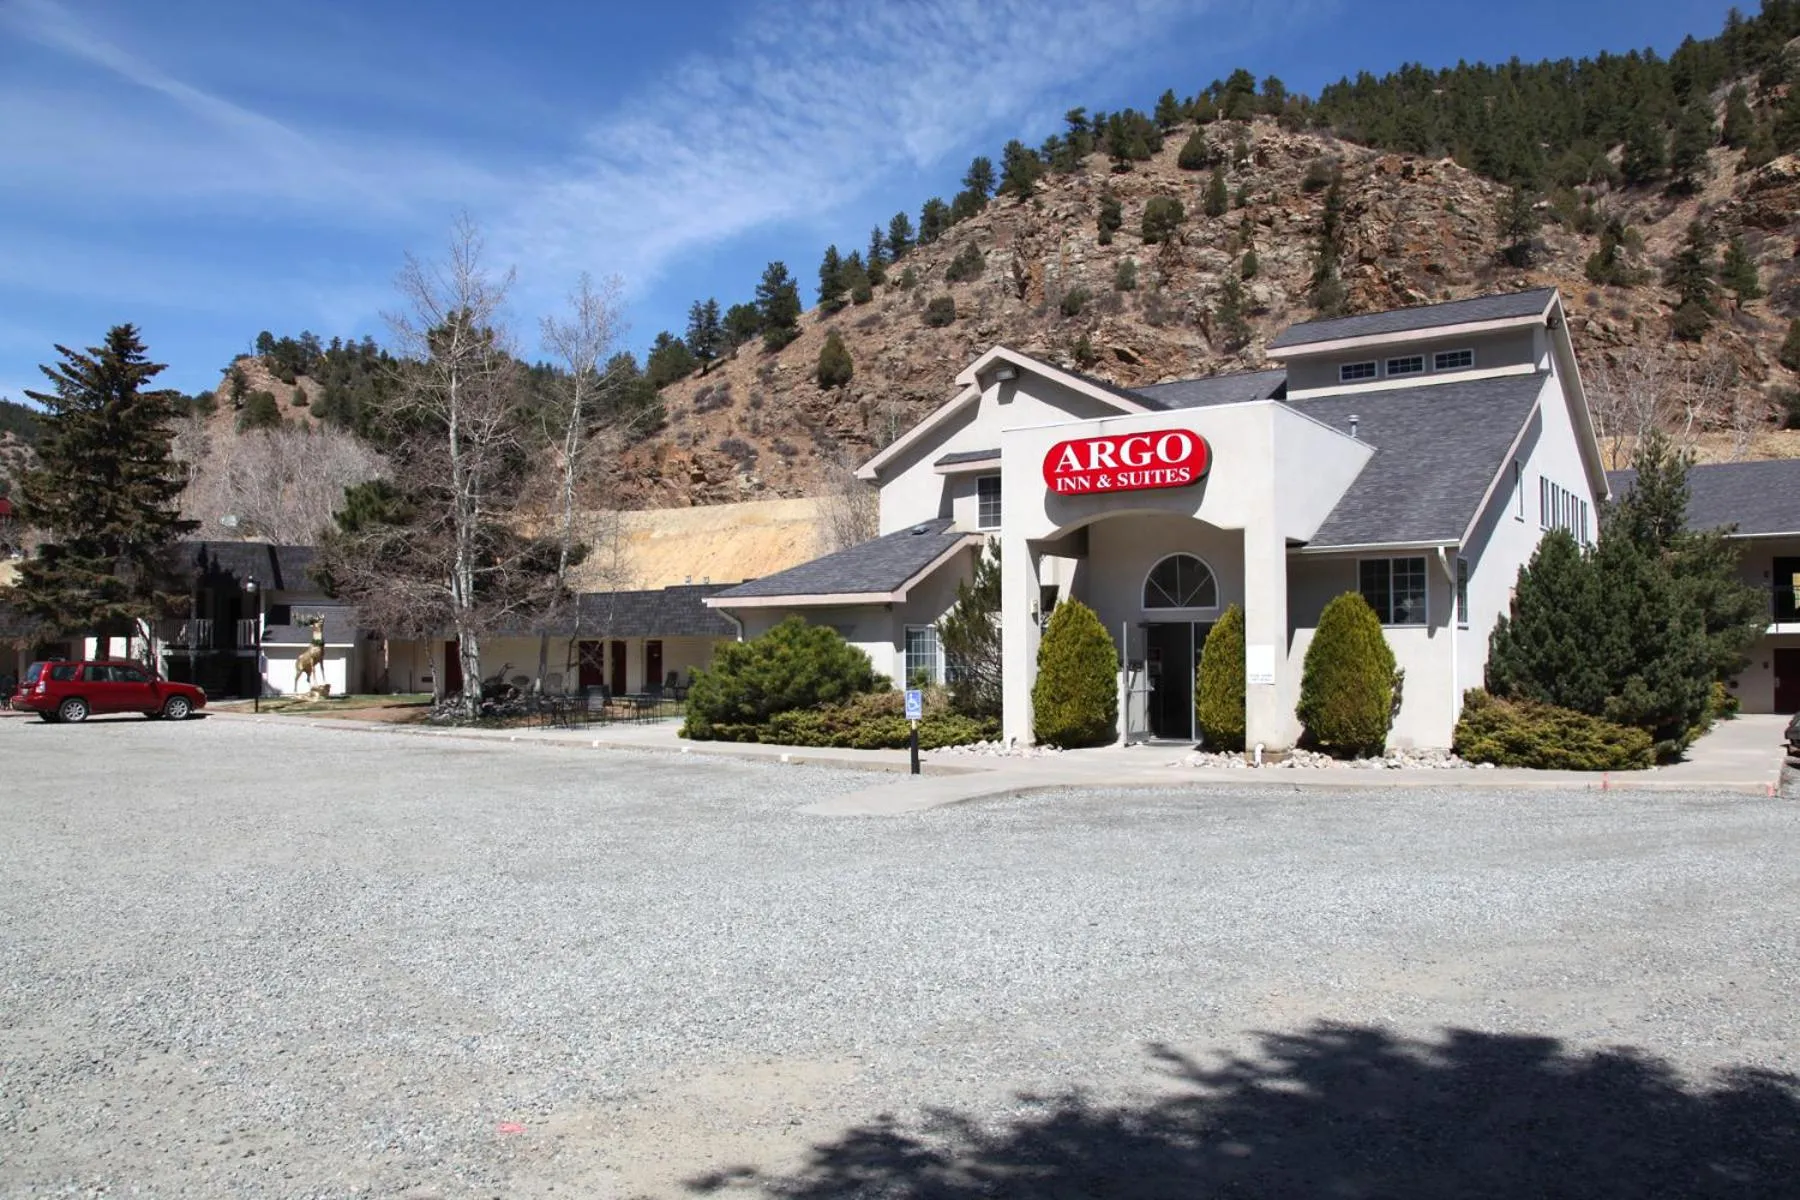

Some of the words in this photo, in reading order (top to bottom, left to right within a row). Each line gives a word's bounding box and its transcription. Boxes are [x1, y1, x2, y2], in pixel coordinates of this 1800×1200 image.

[1055, 433, 1192, 472] ARGO
[1056, 475, 1090, 491] INN
[1096, 474, 1111, 488] &
[1117, 467, 1190, 487] SUITES
